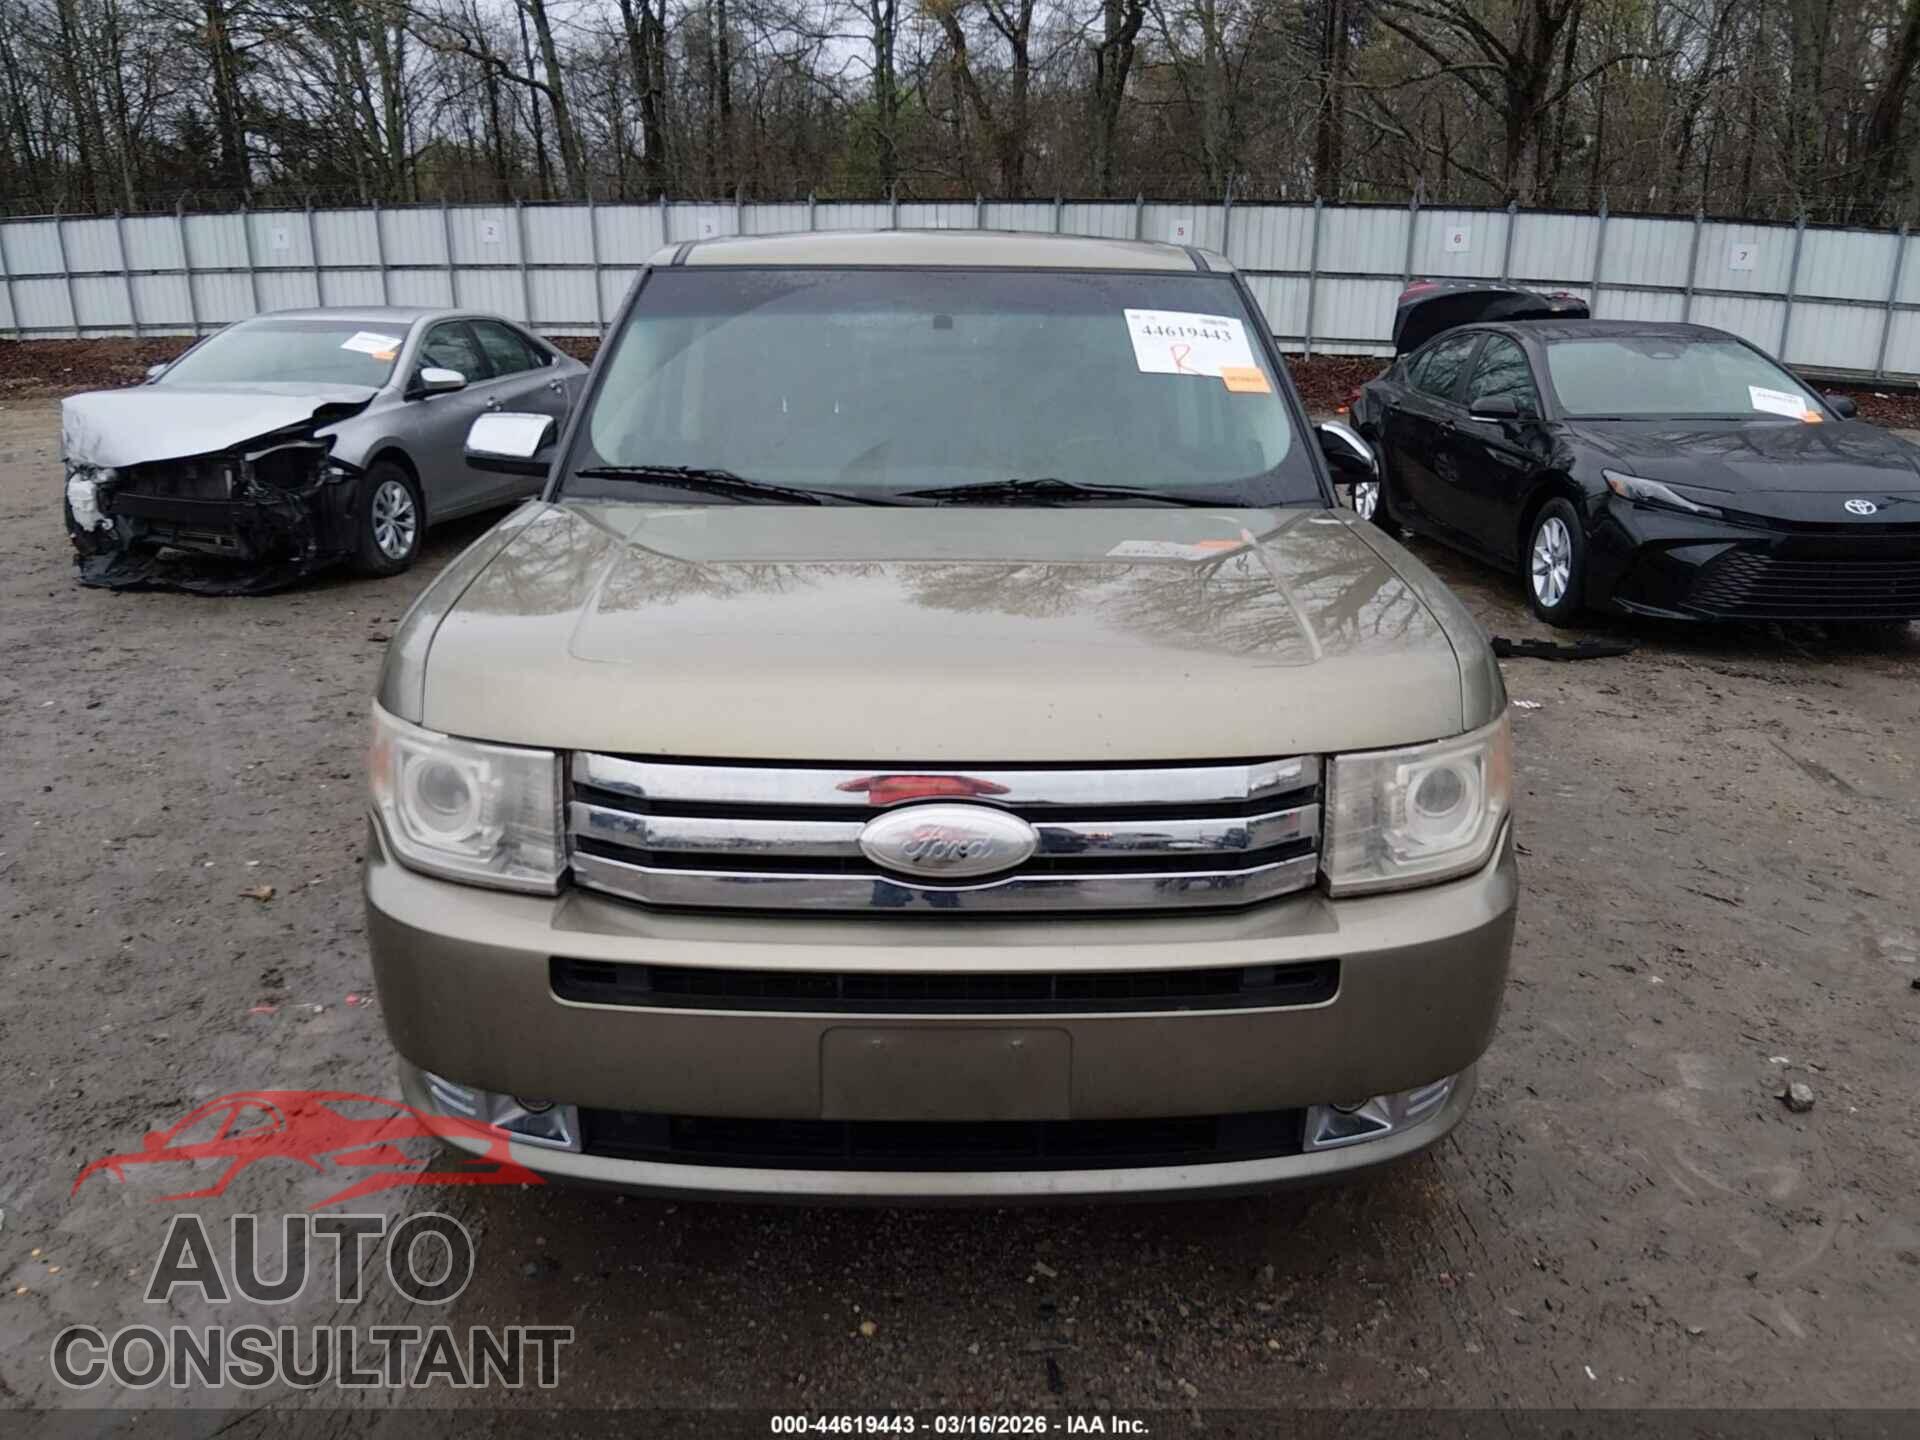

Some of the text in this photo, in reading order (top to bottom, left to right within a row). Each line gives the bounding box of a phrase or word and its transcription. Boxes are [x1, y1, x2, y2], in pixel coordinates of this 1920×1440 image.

[1739, 251, 1748, 261] 7
[1141, 324, 1233, 343] 44619443
[902, 828, 994, 860] Ford
